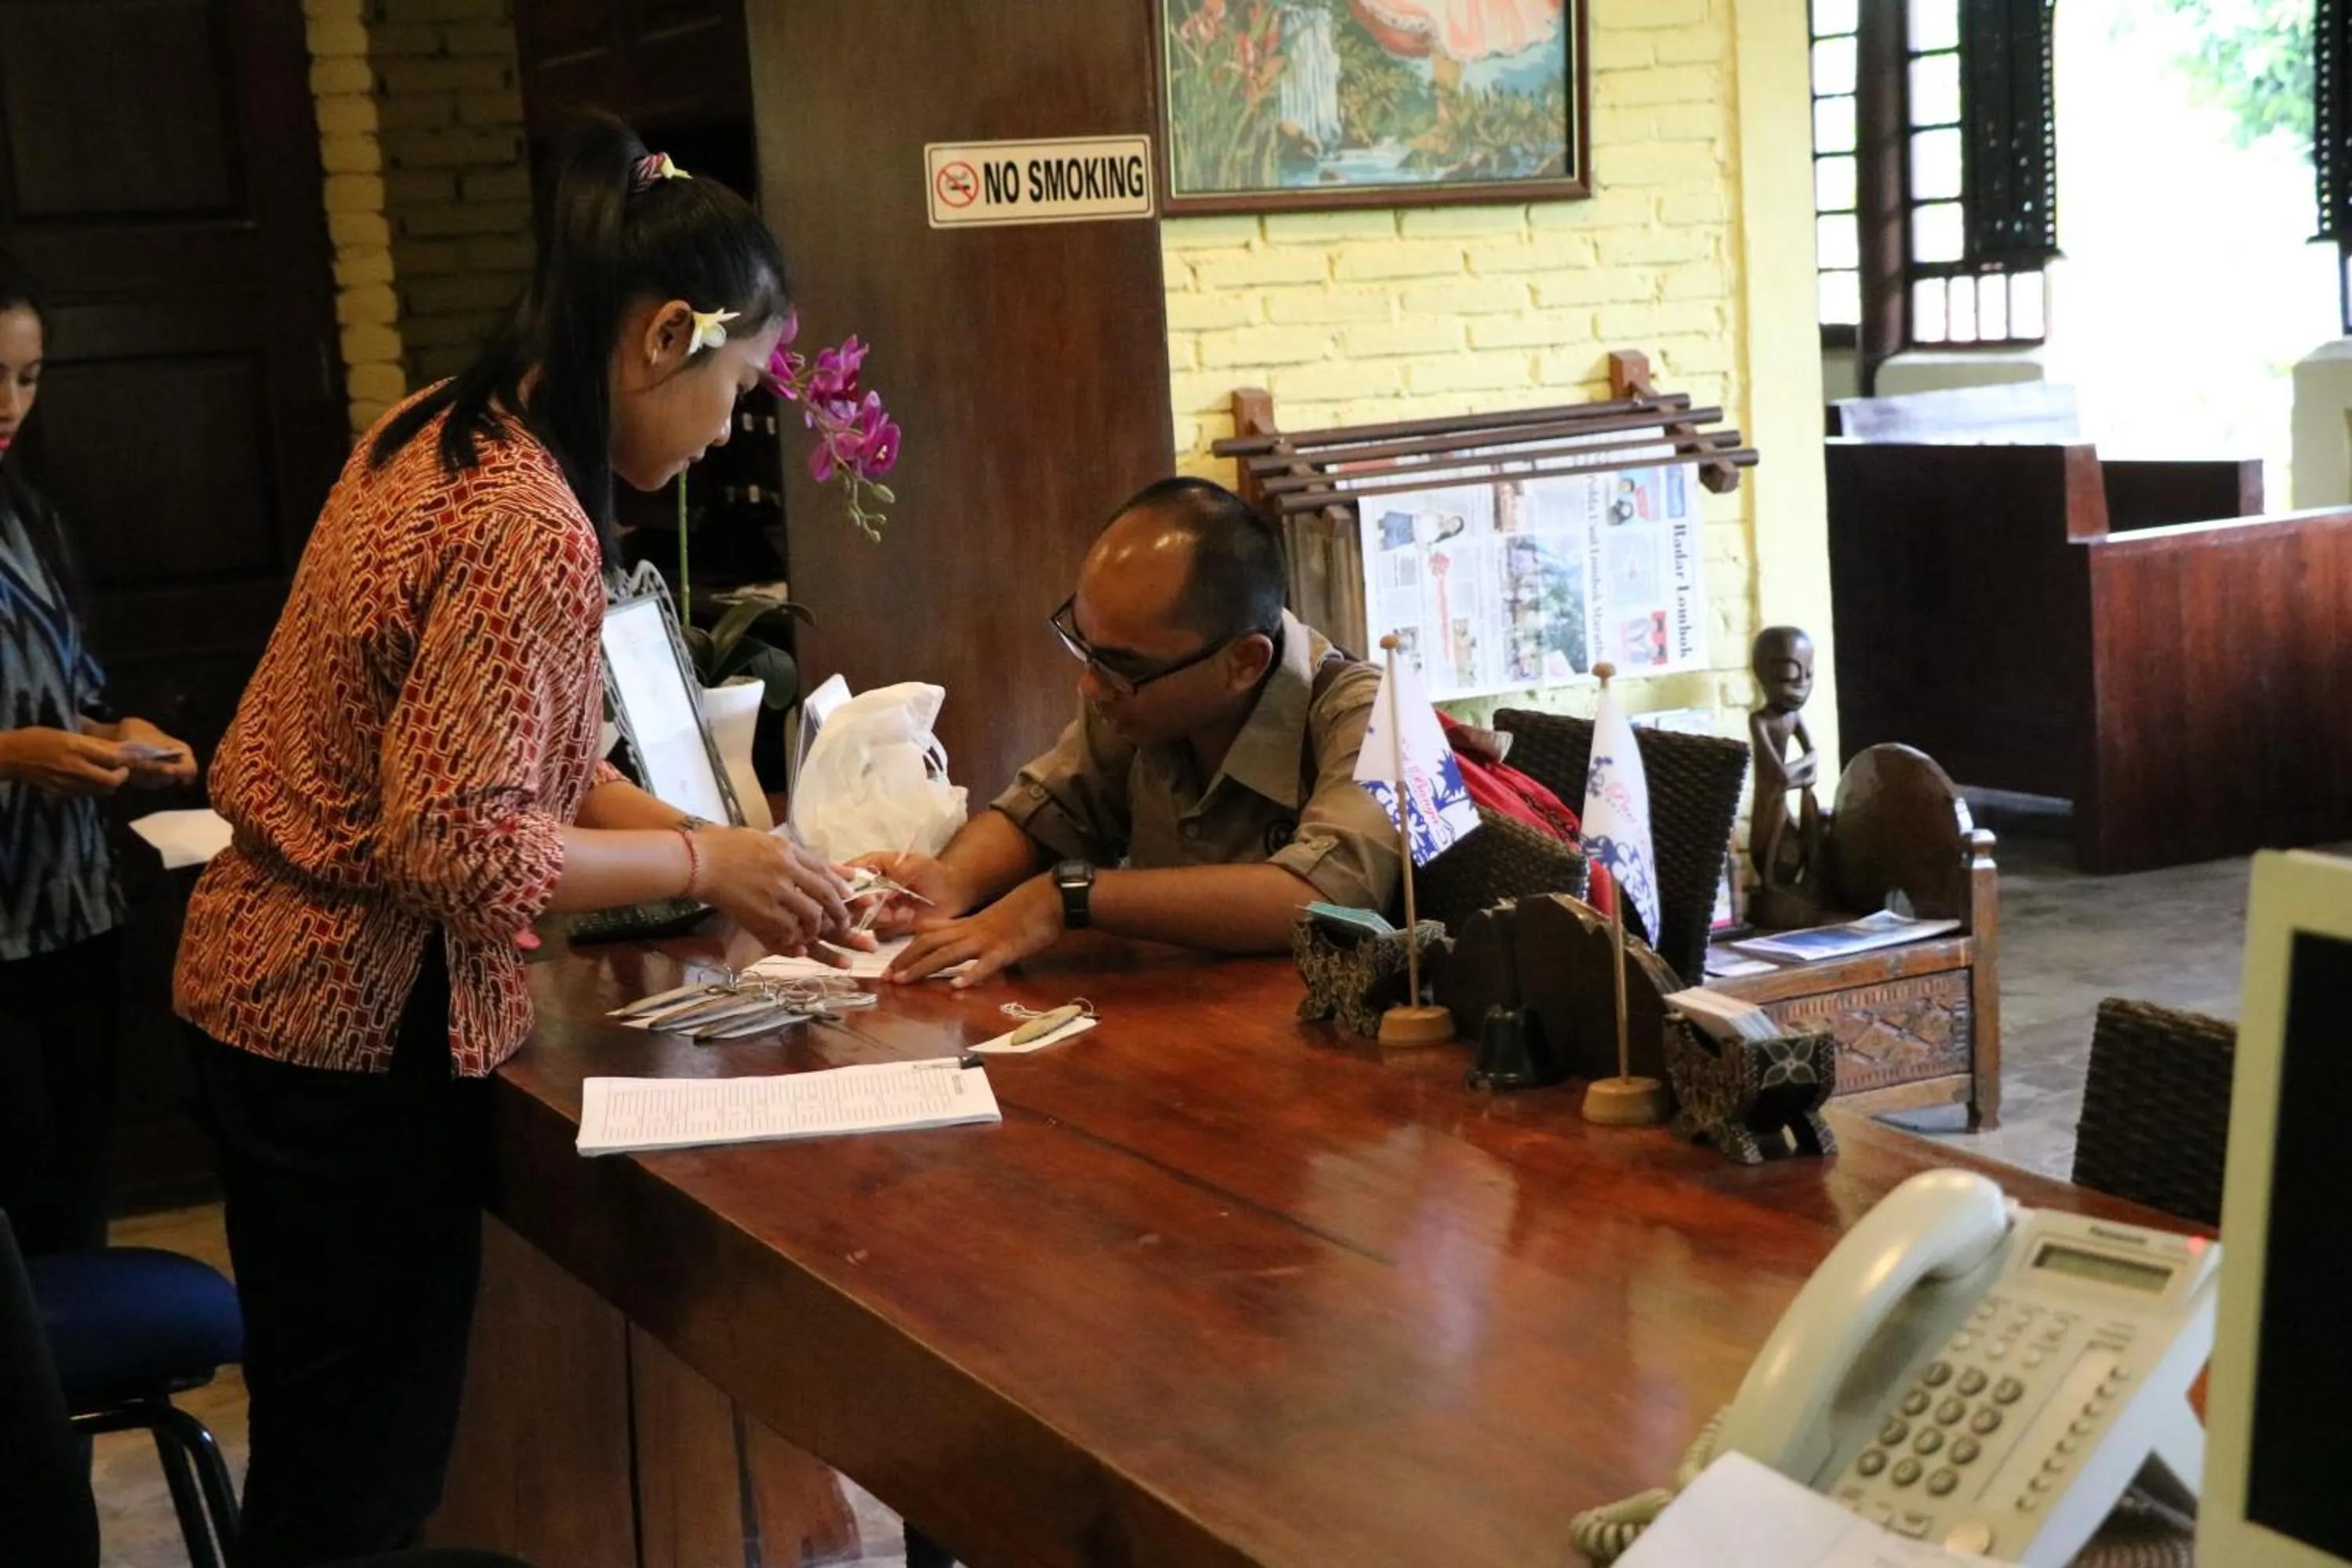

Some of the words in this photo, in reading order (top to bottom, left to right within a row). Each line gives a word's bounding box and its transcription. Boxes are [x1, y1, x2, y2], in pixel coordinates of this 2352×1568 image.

[984, 161, 1019, 204] NO
[1028, 155, 1144, 202] SMOKING
[1673, 524, 1688, 579] Radar
[1676, 586, 1693, 658] Lombok
